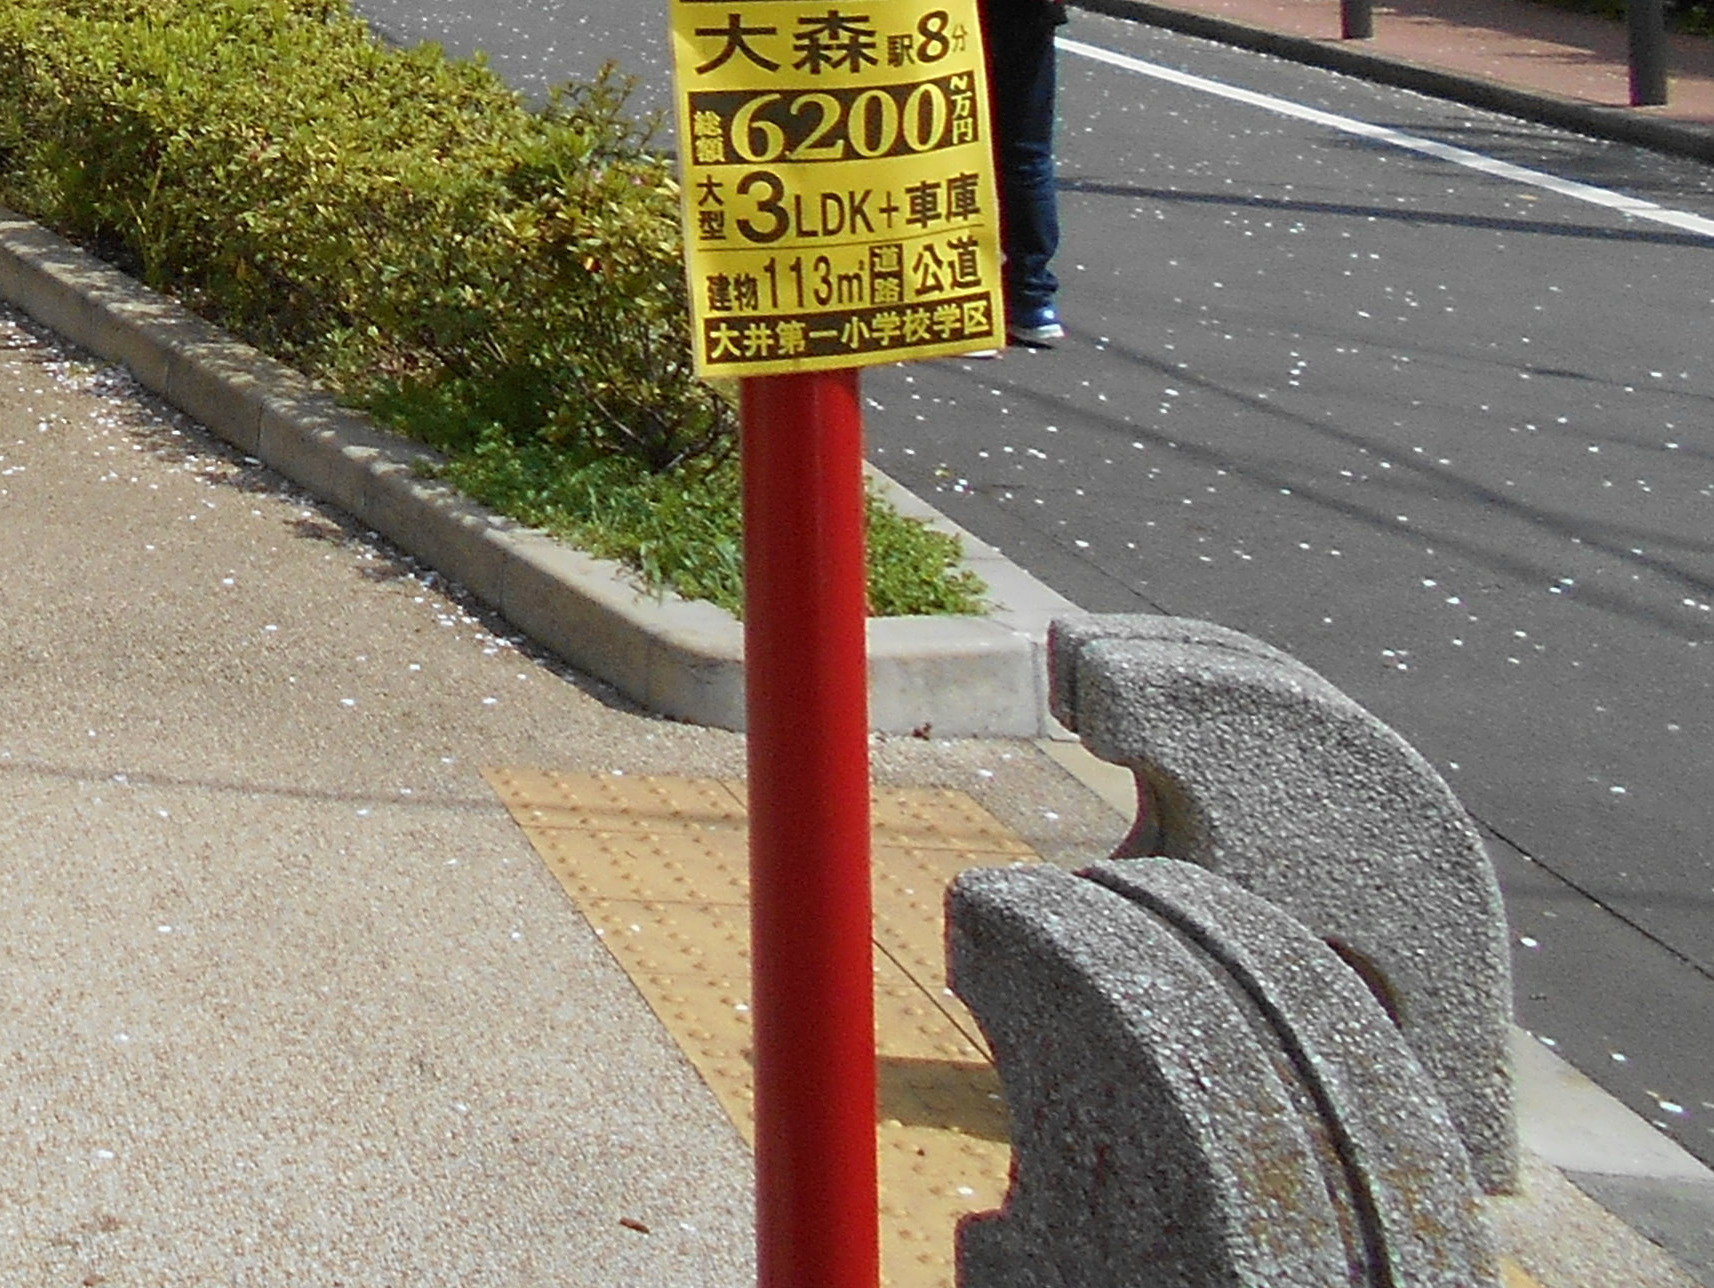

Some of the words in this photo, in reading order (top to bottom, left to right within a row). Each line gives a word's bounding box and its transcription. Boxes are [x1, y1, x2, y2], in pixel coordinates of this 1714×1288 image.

[695, 174, 727, 241] 大型
[873, 245, 901, 304] 道路
[912, 234, 983, 296] 公道
[709, 300, 991, 360] 大井第一小学校学区
